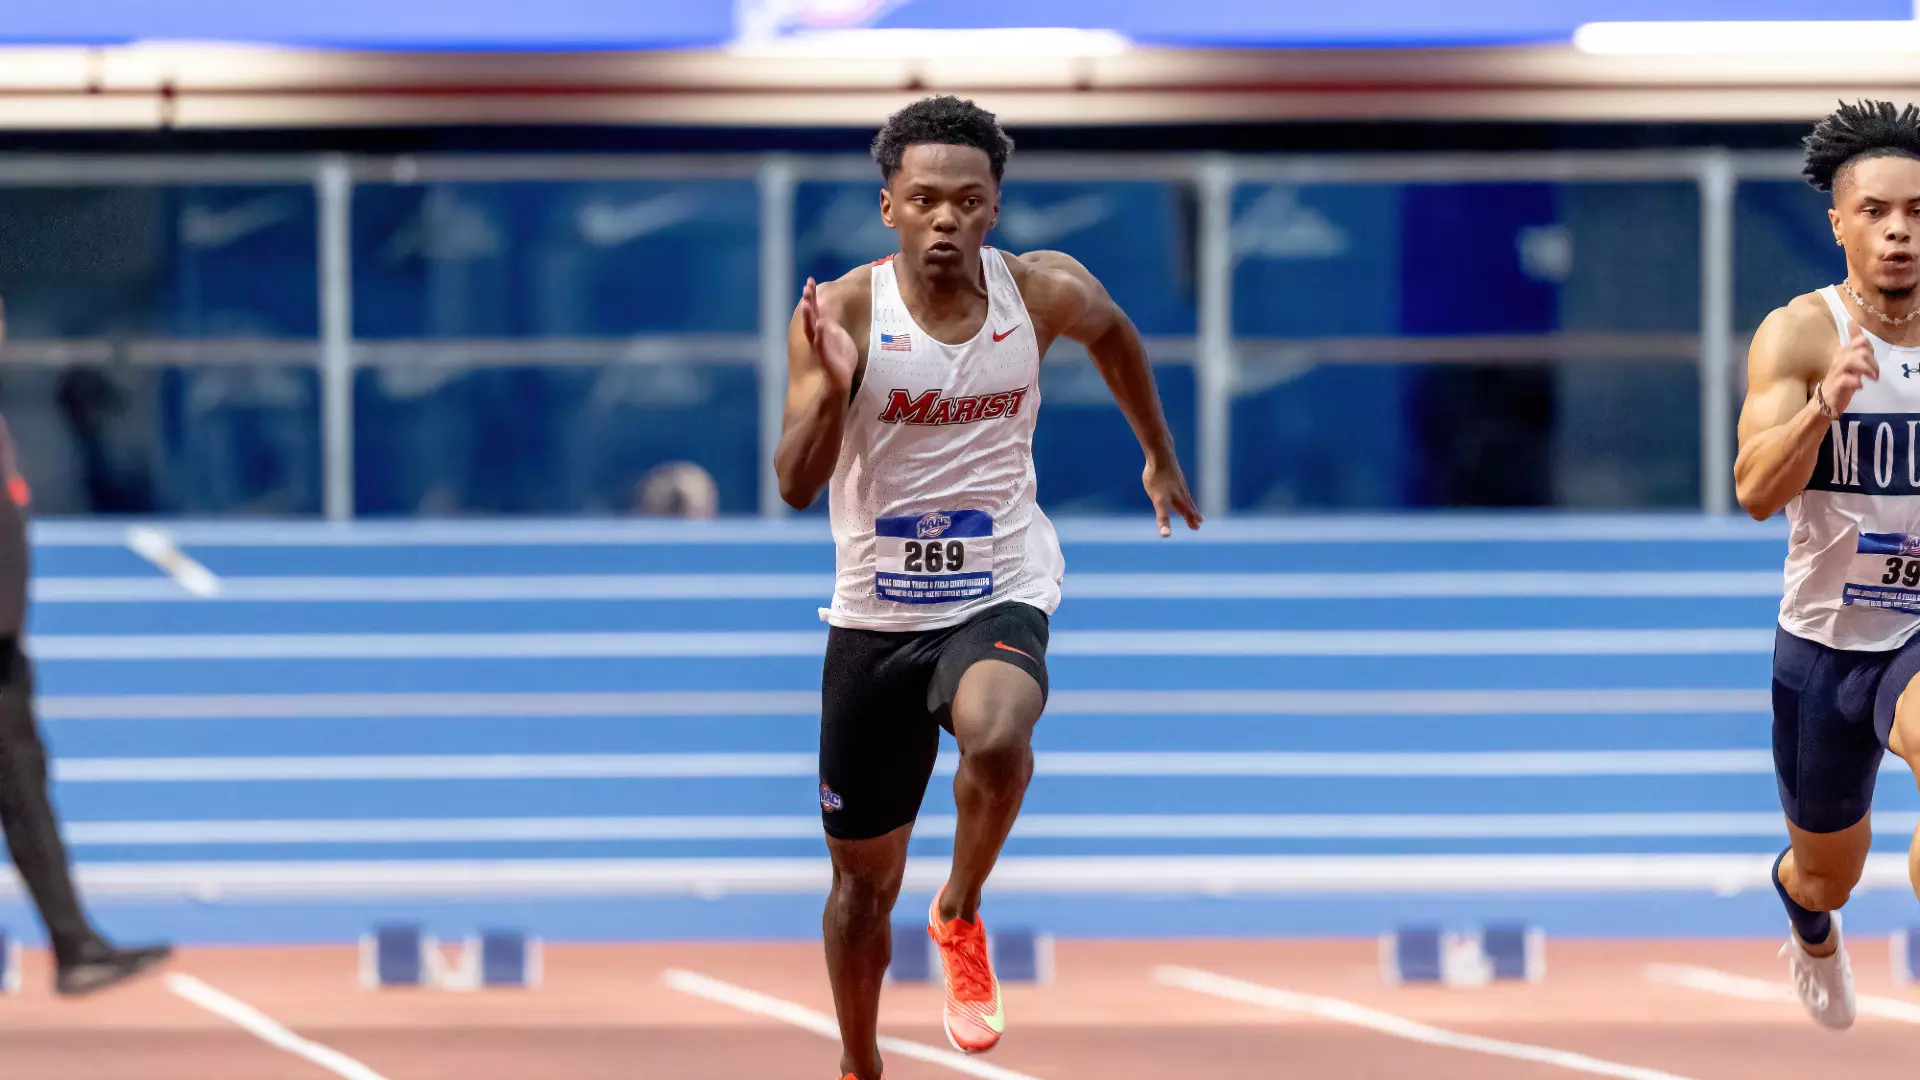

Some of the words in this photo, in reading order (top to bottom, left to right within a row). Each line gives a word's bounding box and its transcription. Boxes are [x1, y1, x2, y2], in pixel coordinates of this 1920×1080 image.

[878, 384, 1030, 426] MARIST
[904, 540, 965, 572] 269
[1881, 557, 1920, 588] 39
